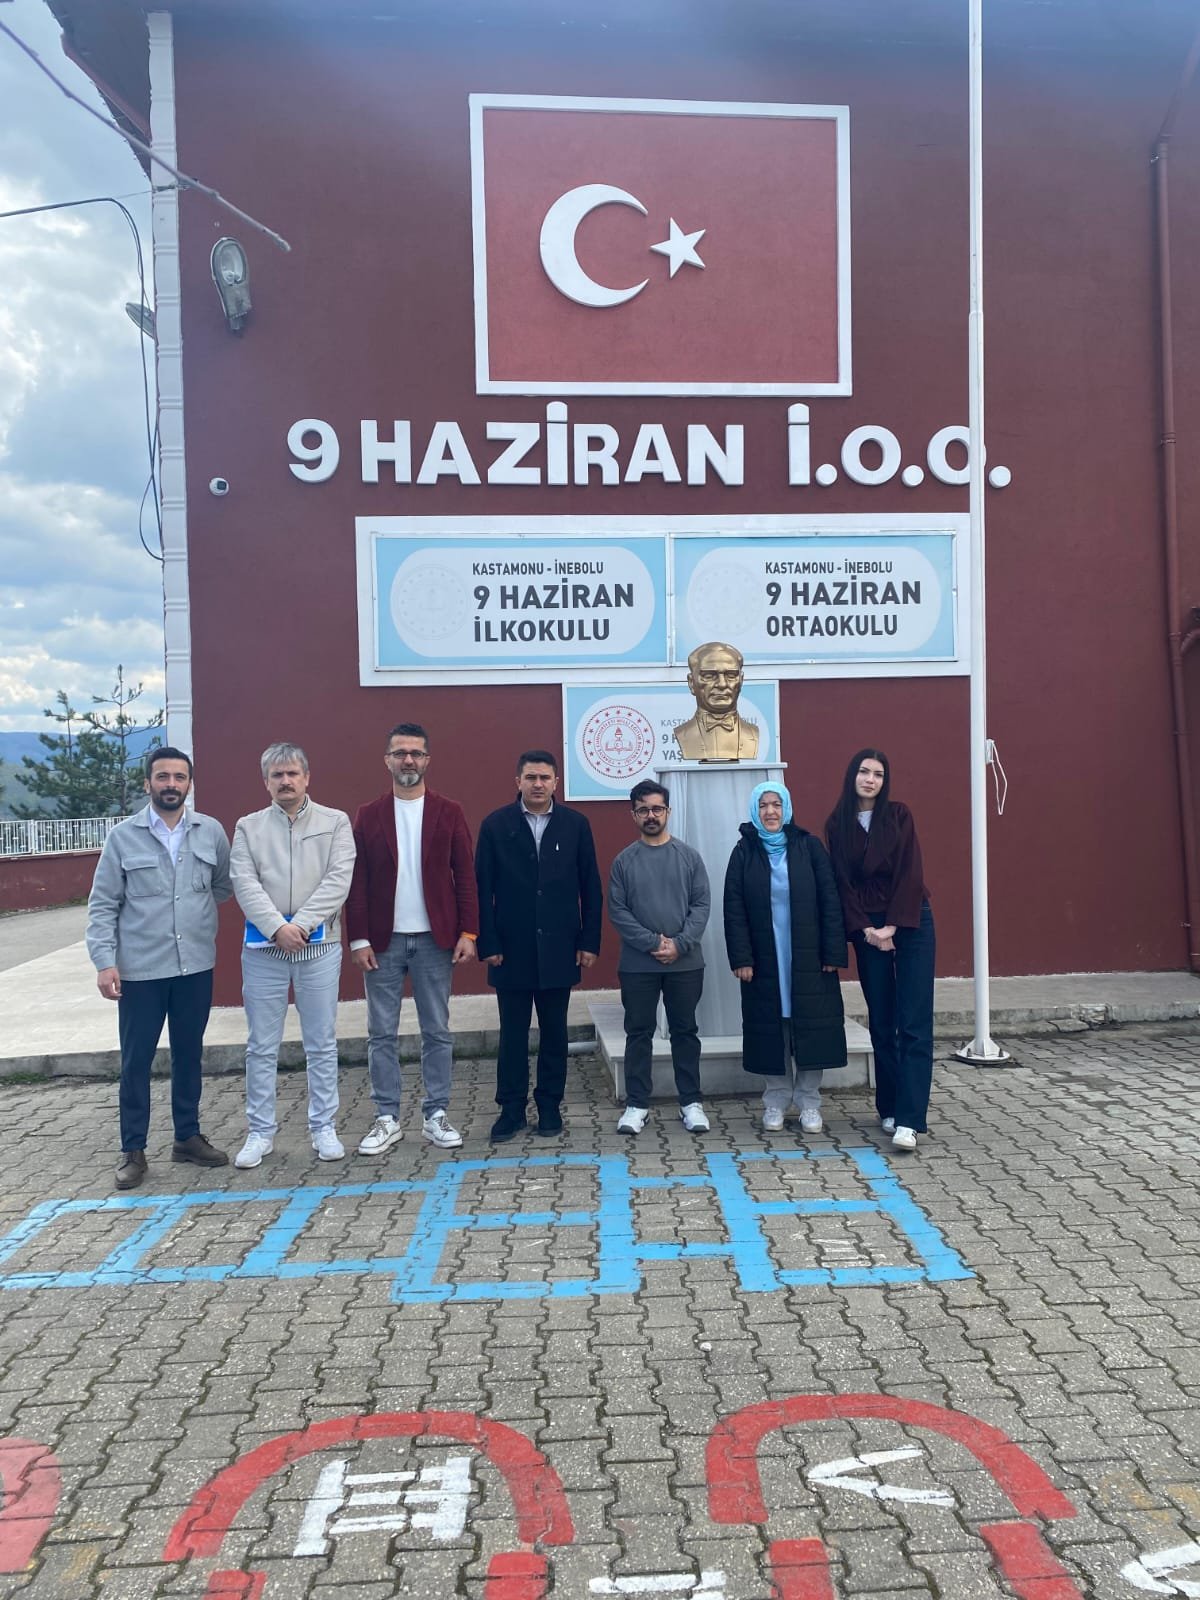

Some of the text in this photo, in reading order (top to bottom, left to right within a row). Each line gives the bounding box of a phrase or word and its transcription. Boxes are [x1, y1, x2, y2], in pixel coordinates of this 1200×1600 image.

[287, 418, 340, 483] 9
[360, 400, 745, 486] HAZİRAN
[472, 562, 544, 576] KASTAMONU
[554, 559, 604, 575] İNEBOLU
[765, 561, 834, 574] KASTAMONU
[844, 558, 893, 574] İNEBOLU
[473, 577, 634, 609] 9 HAZİRAN
[766, 574, 921, 606] 9 HAZİRAN
[474, 615, 610, 642] İLKOKULU
[766, 614, 898, 637] ORTAOKULU
[661, 733, 669, 744] 9
